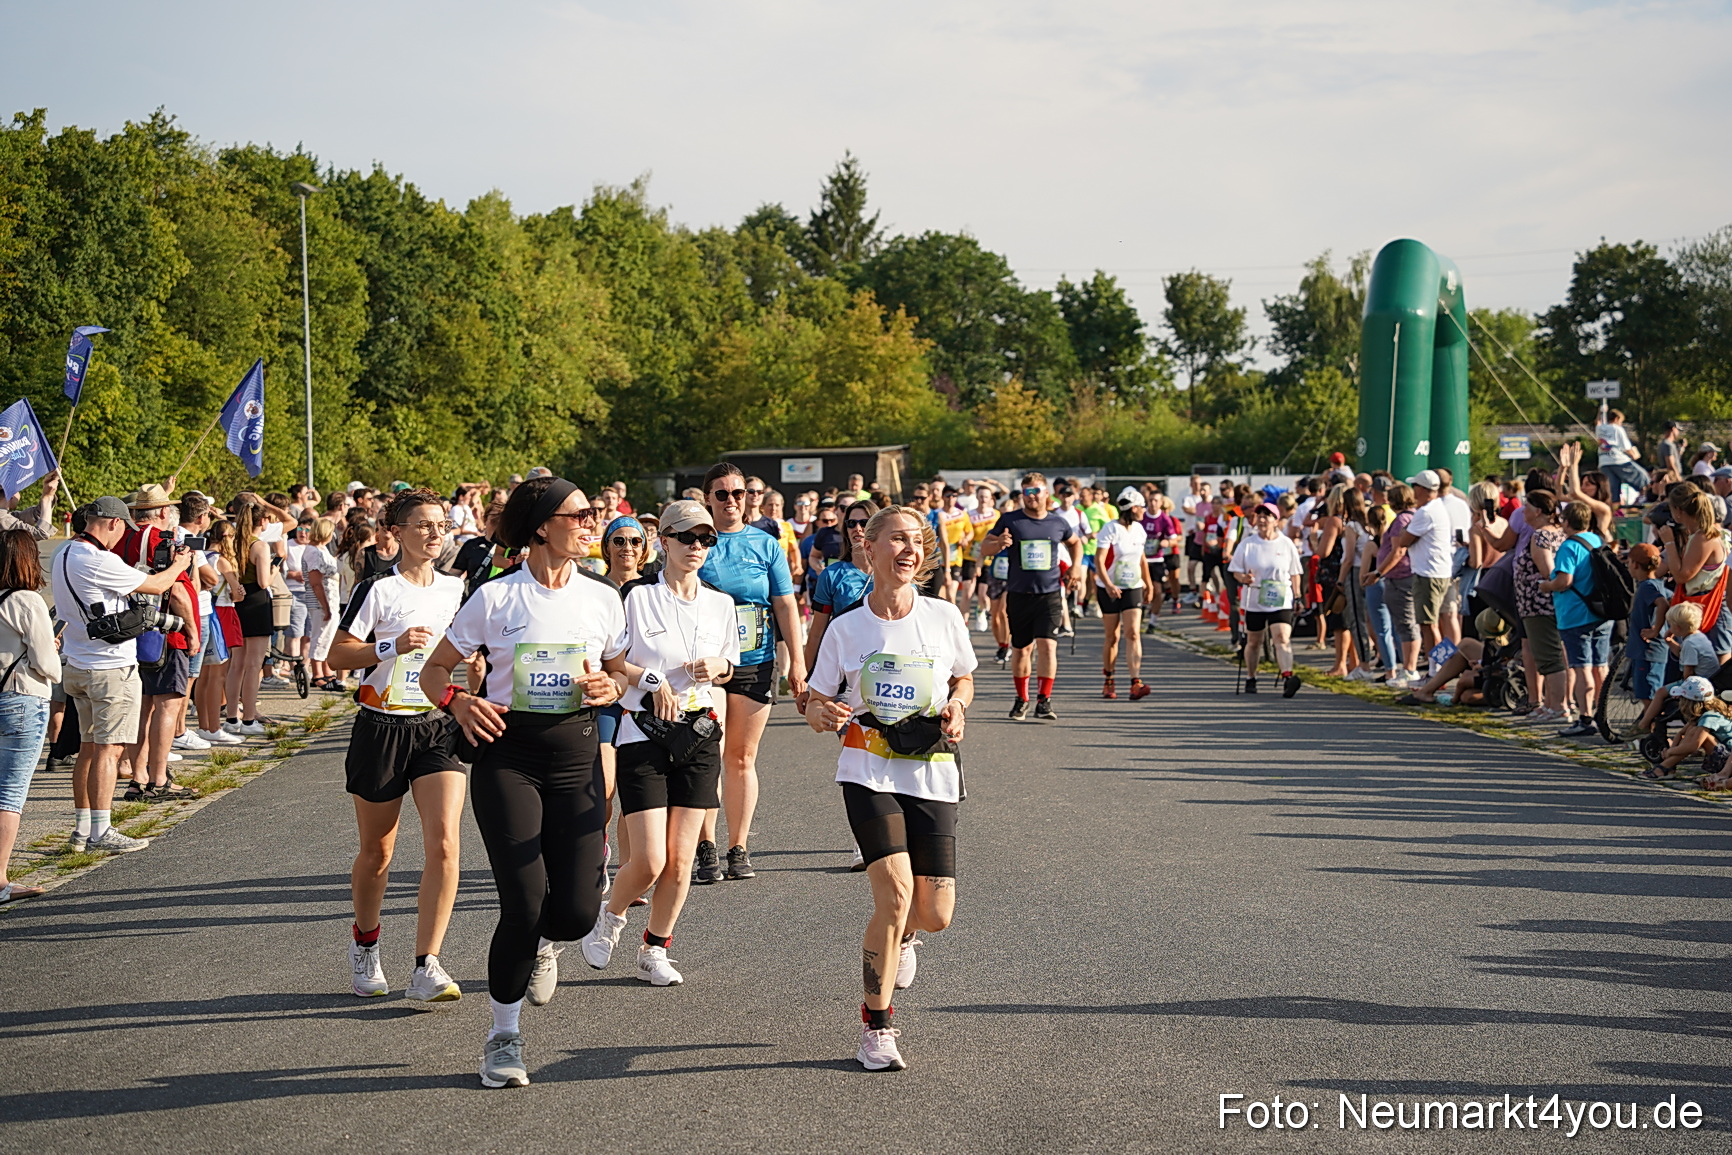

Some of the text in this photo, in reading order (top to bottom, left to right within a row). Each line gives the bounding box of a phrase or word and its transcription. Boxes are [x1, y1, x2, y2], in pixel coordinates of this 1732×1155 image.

[405, 671, 420, 683] 12
[529, 672, 570, 687] 1236
[875, 682, 915, 701] 1238
[866, 698, 897, 709] Stephanie
